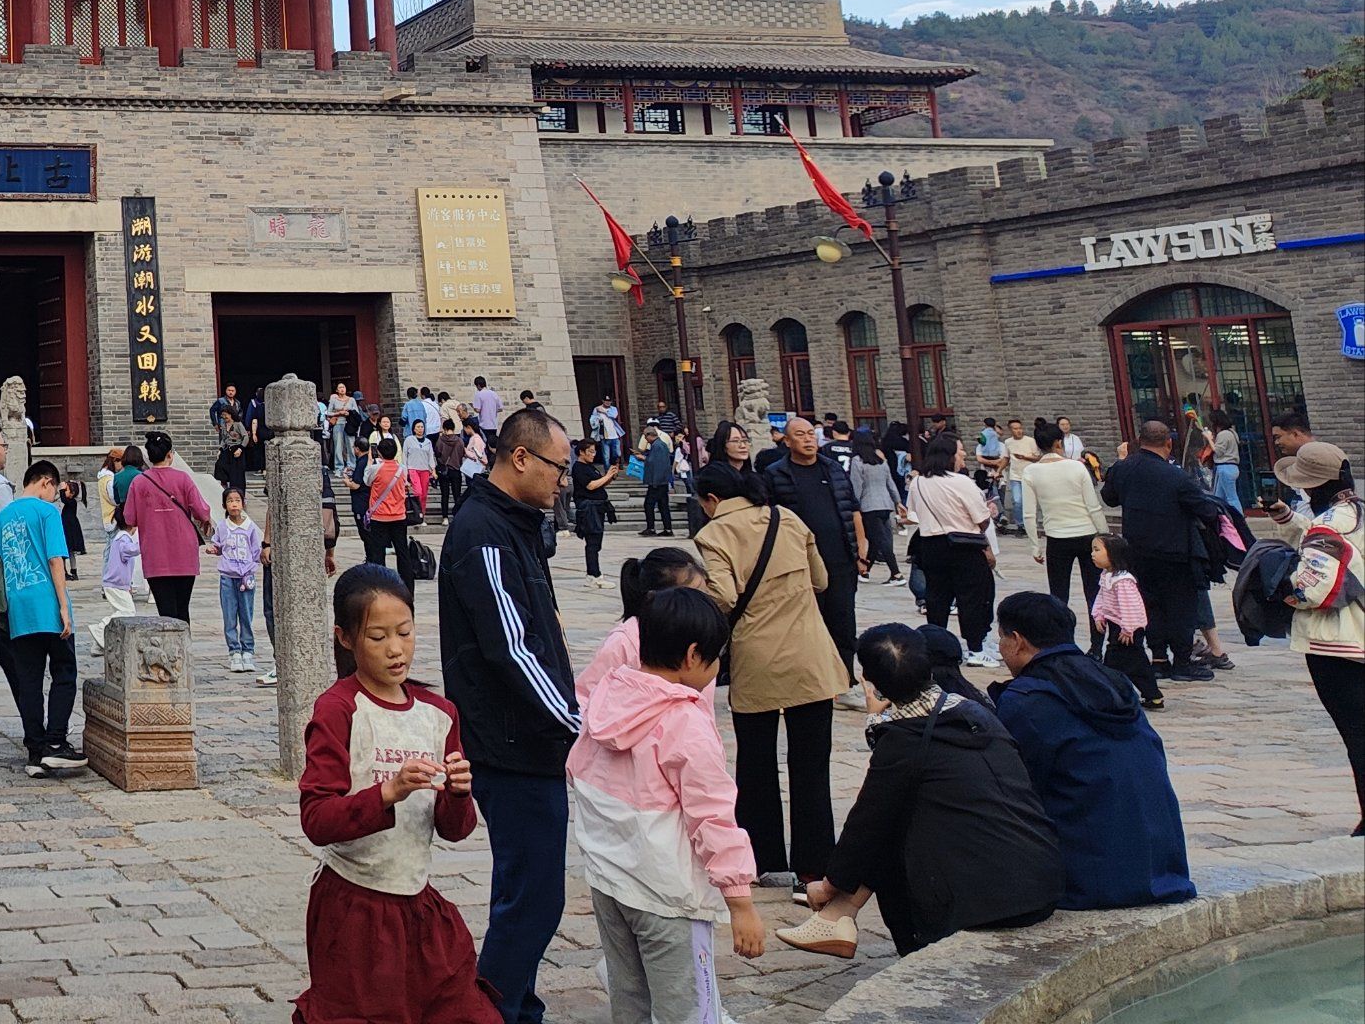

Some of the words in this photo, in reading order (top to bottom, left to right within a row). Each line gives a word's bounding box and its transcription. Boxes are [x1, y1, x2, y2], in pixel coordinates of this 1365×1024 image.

[426, 206, 501, 222] 游客服务中心
[1080, 215, 1258, 272] LAWSON
